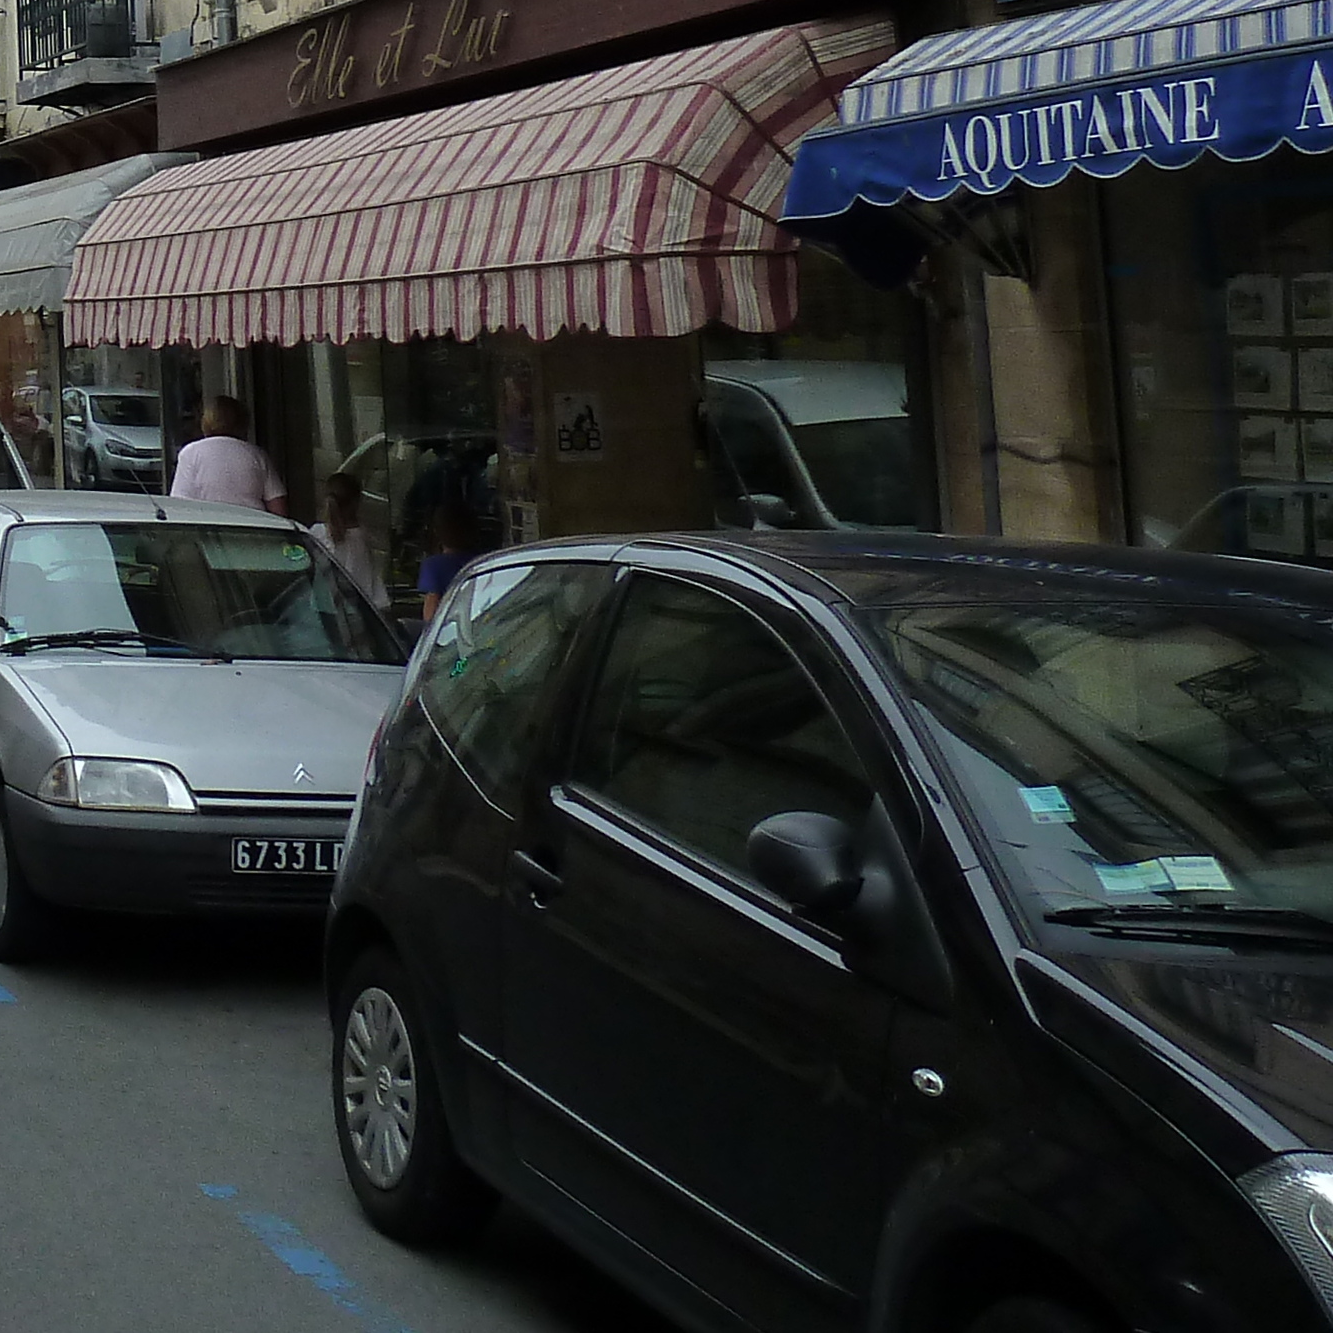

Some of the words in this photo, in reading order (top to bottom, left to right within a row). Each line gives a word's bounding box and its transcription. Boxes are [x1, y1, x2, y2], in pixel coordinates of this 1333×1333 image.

[287, 12, 355, 108] Elle
[374, 2, 415, 88] et
[936, 77, 1220, 188] AQUITAINE
[236, 840, 306, 870] 6733
